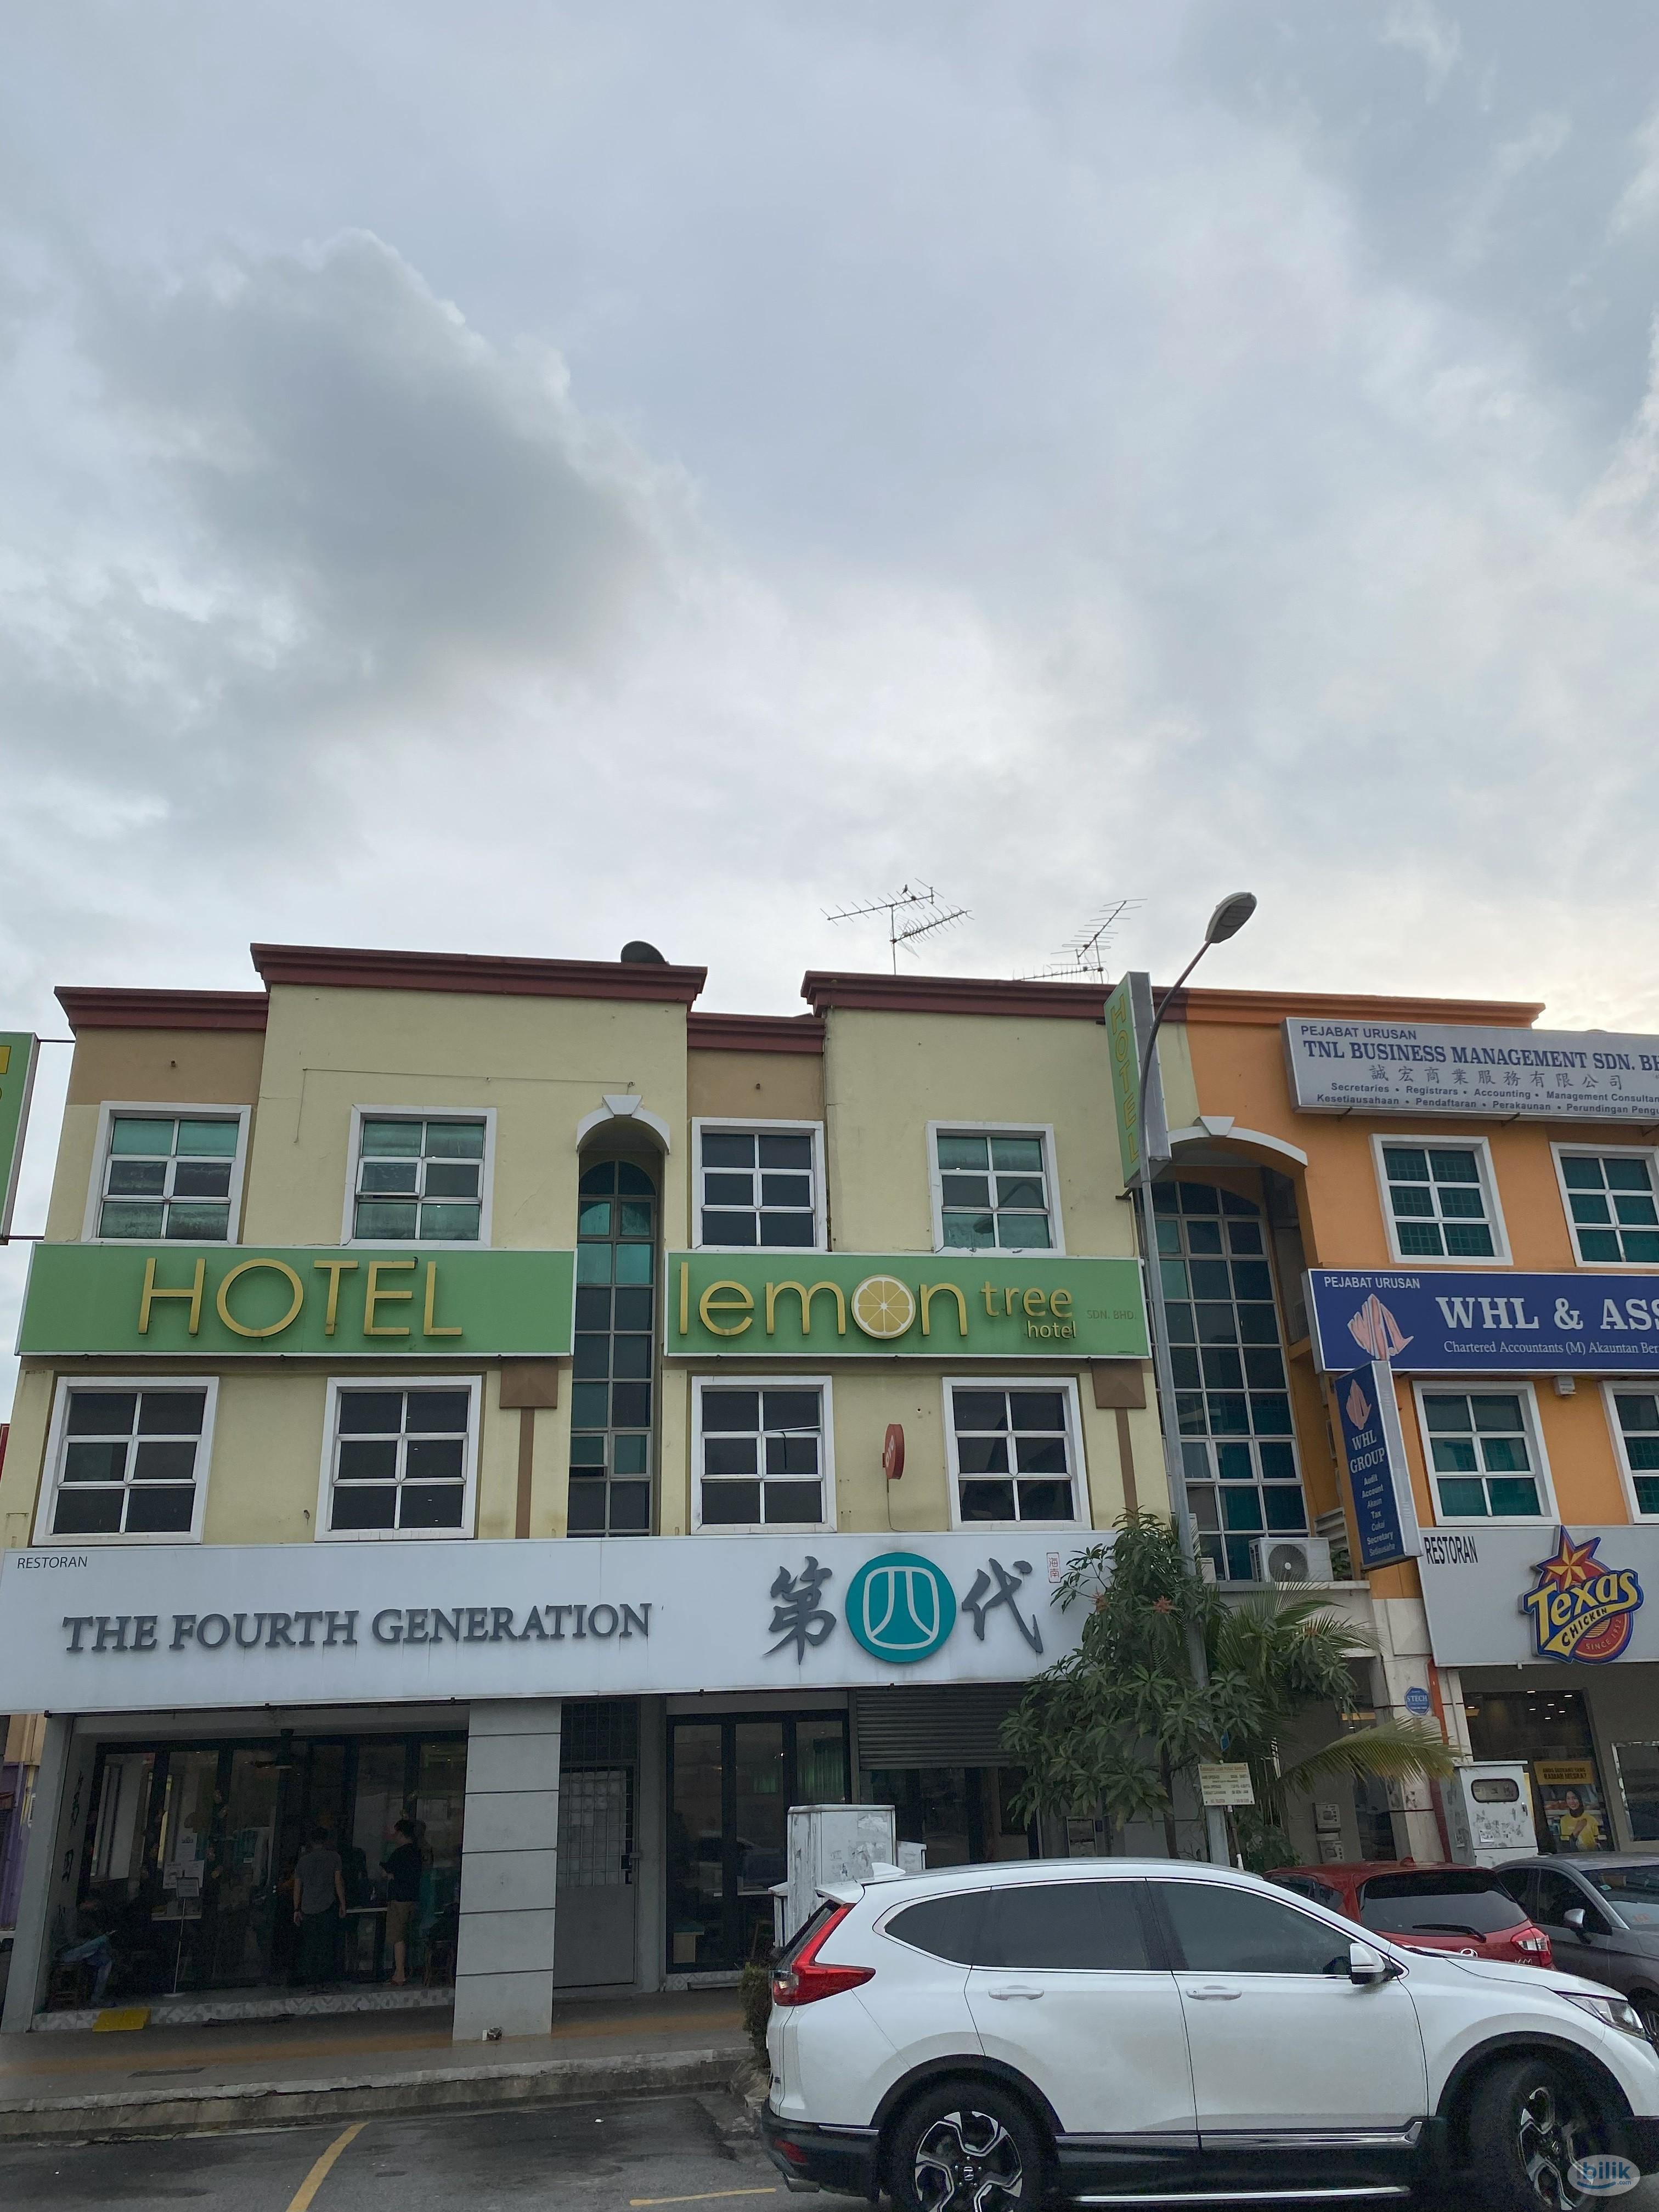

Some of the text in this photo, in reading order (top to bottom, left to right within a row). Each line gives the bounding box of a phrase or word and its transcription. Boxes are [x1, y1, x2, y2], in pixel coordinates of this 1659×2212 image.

[1301, 1026, 1417, 1040] PEJABAT URUSAN
[1303, 1040, 1344, 1058] TNL
[1349, 1042, 1446, 1063] BUSINESS
[1450, 1046, 1587, 1068] MANAGEMENT
[1593, 1053, 1635, 1070] SDN.
[1110, 993, 1139, 1164] HOTEL
[1369, 1064, 1622, 1090] 誠宏商業服務有限公司
[1331, 1082, 1389, 1093] Secretaries
[1406, 1086, 1458, 1096] Registrars
[1474, 1088, 1531, 1099] Accounting
[1547, 1091, 1607, 1102] Management
[1317, 1093, 1399, 1105] Kesetiausahaan
[1415, 1098, 1476, 1108] Pendaftaran
[1493, 1101, 1551, 1110] Perakaunan
[1566, 1104, 1628, 1114] Perundingan
[1324, 1276, 1420, 1289] PEJABAT URUSAN
[138, 1257, 463, 1338] HOTEL
[679, 1262, 1073, 1339] lemon tree
[1087, 1310, 1110, 1319] SDN.
[1435, 1297, 1539, 1329] WHL
[1554, 1297, 1584, 1330] &
[1027, 1320, 1076, 1339] hotel
[1443, 1340, 1496, 1353] Chartered
[1499, 1342, 1564, 1353] Accountants
[1565, 1342, 1585, 1355] (M)
[1589, 1342, 1639, 1354] Akauntan
[1351, 1429, 1378, 1451] WHL
[1350, 1447, 1385, 1474] GROUP
[1362, 1484, 1384, 1499] Account
[1371, 1510, 1382, 1519] Tax
[1367, 1531, 1393, 1545] Secretary
[1424, 1536, 1479, 1564] RESTORAN
[17, 1556, 88, 1569] RESTORAN
[1527, 1572, 1638, 1646] Texas
[62, 1603, 652, 1651] THE FOURTH GENERATION
[1561, 1607, 1607, 1646] CHICKEN
[1585, 1638, 1611, 1650] SINCE
